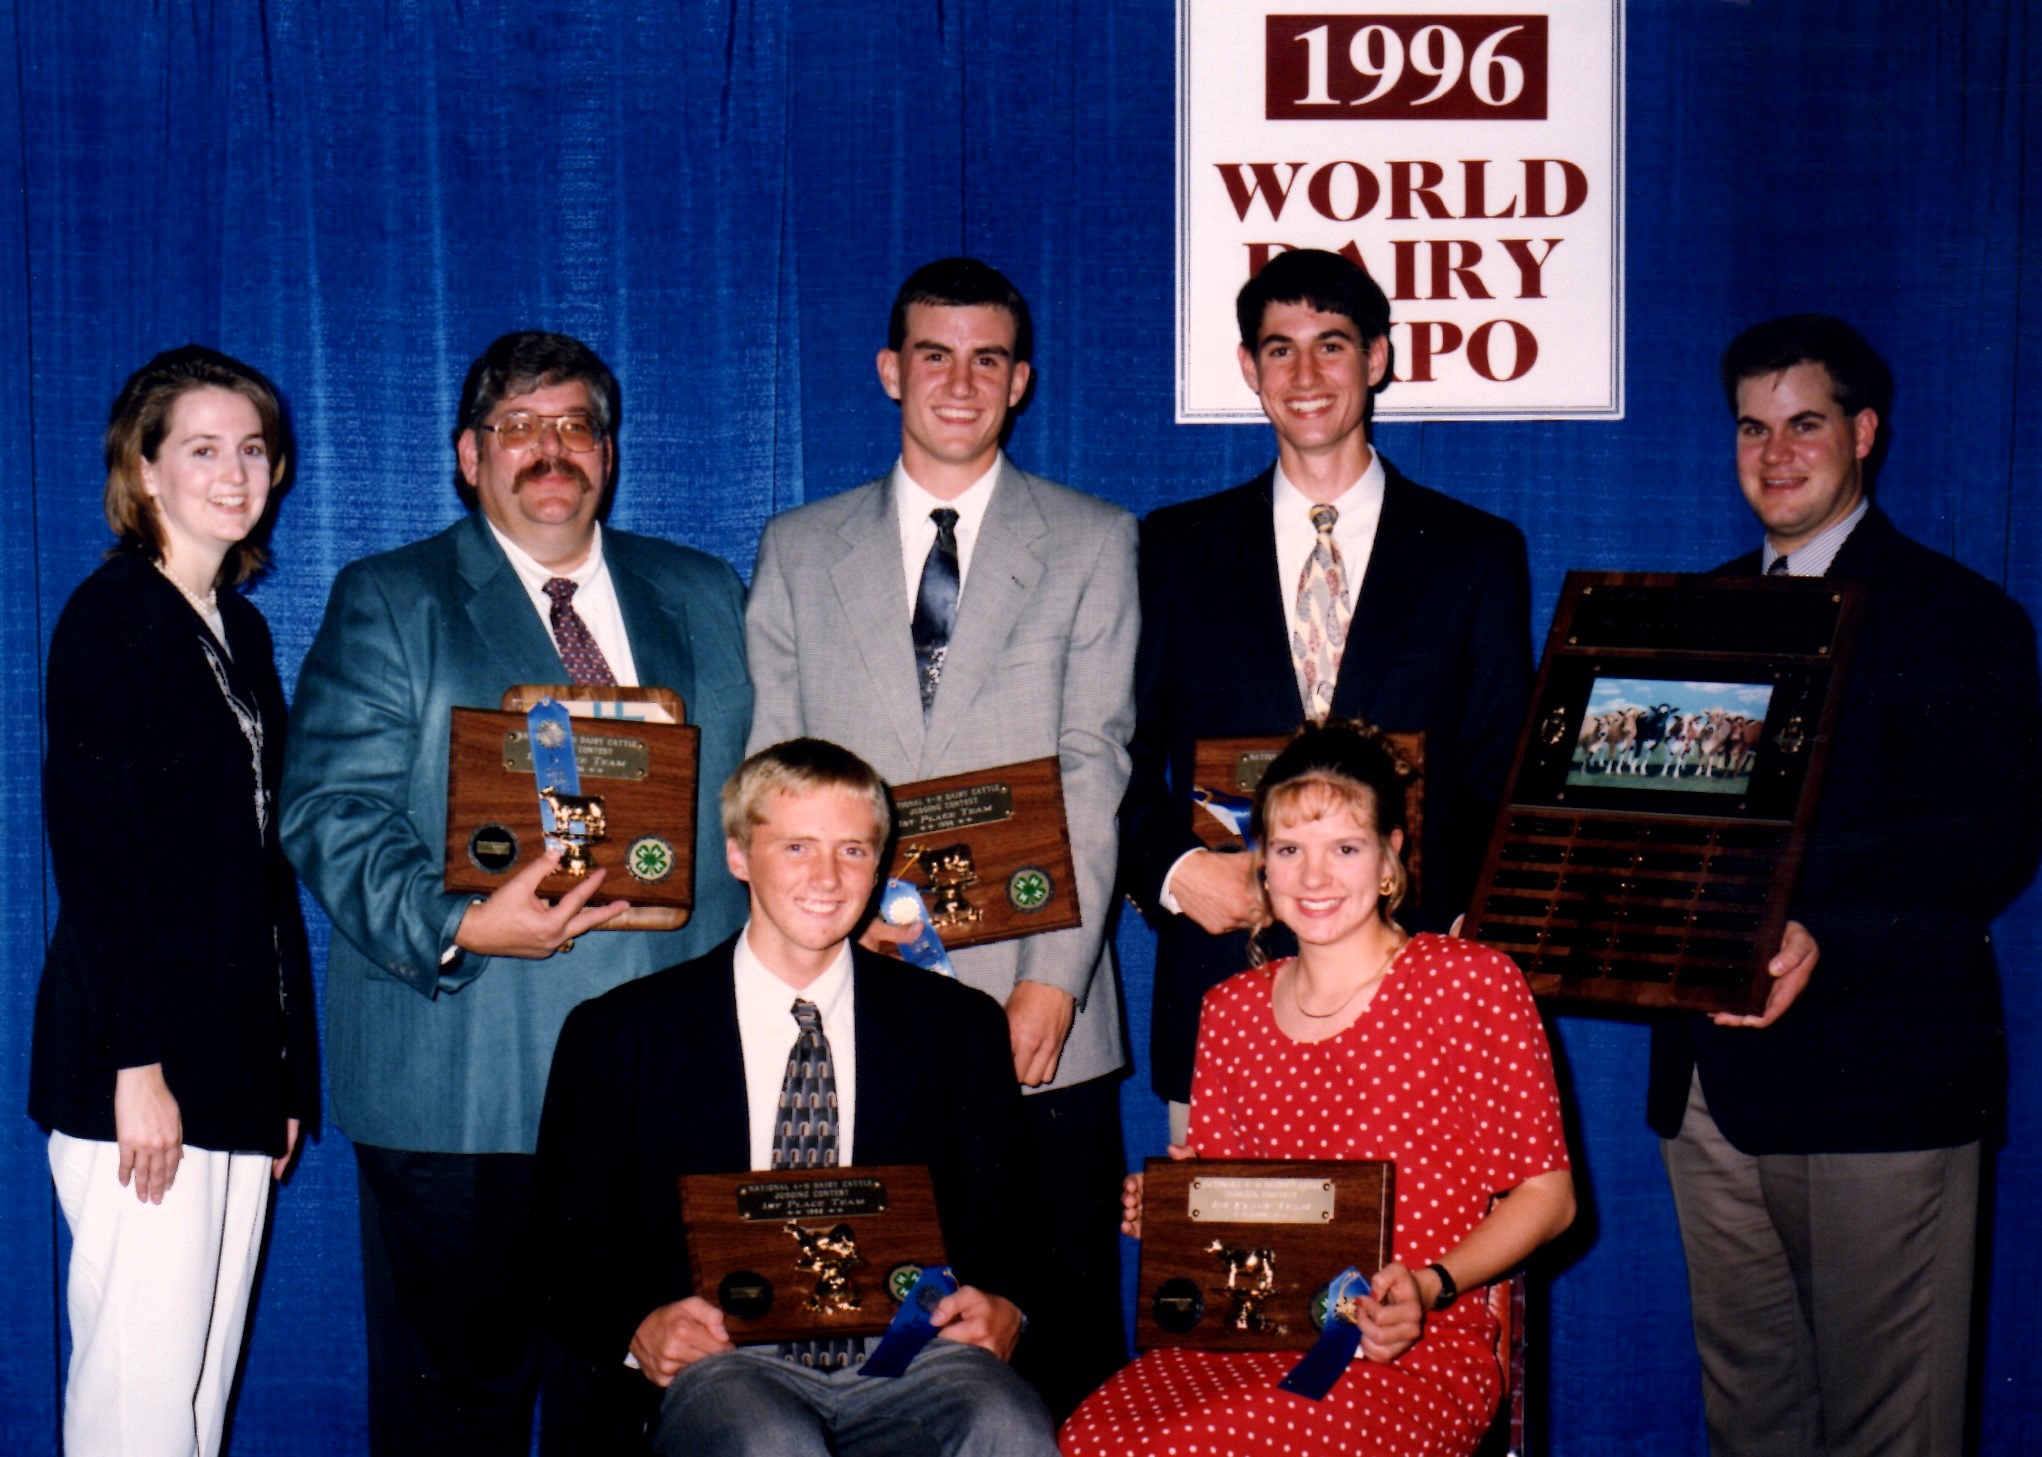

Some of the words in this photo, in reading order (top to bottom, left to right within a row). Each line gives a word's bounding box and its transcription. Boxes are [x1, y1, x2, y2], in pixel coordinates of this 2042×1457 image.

[1293, 24, 1525, 107] 1996
[1212, 158, 1589, 223] WORLD
[1390, 319, 1539, 383] PO
[944, 790, 969, 801] DAIRY
[970, 783, 1001, 796] CATTLE
[944, 796, 979, 809] CONTEST
[748, 1183, 790, 1193] NATIONAL
[813, 1181, 838, 1190] DAIRY
[842, 1179, 873, 1188] CATTLE
[774, 1190, 811, 1200] JUDGING
[812, 1188, 849, 1198] CONTEST
